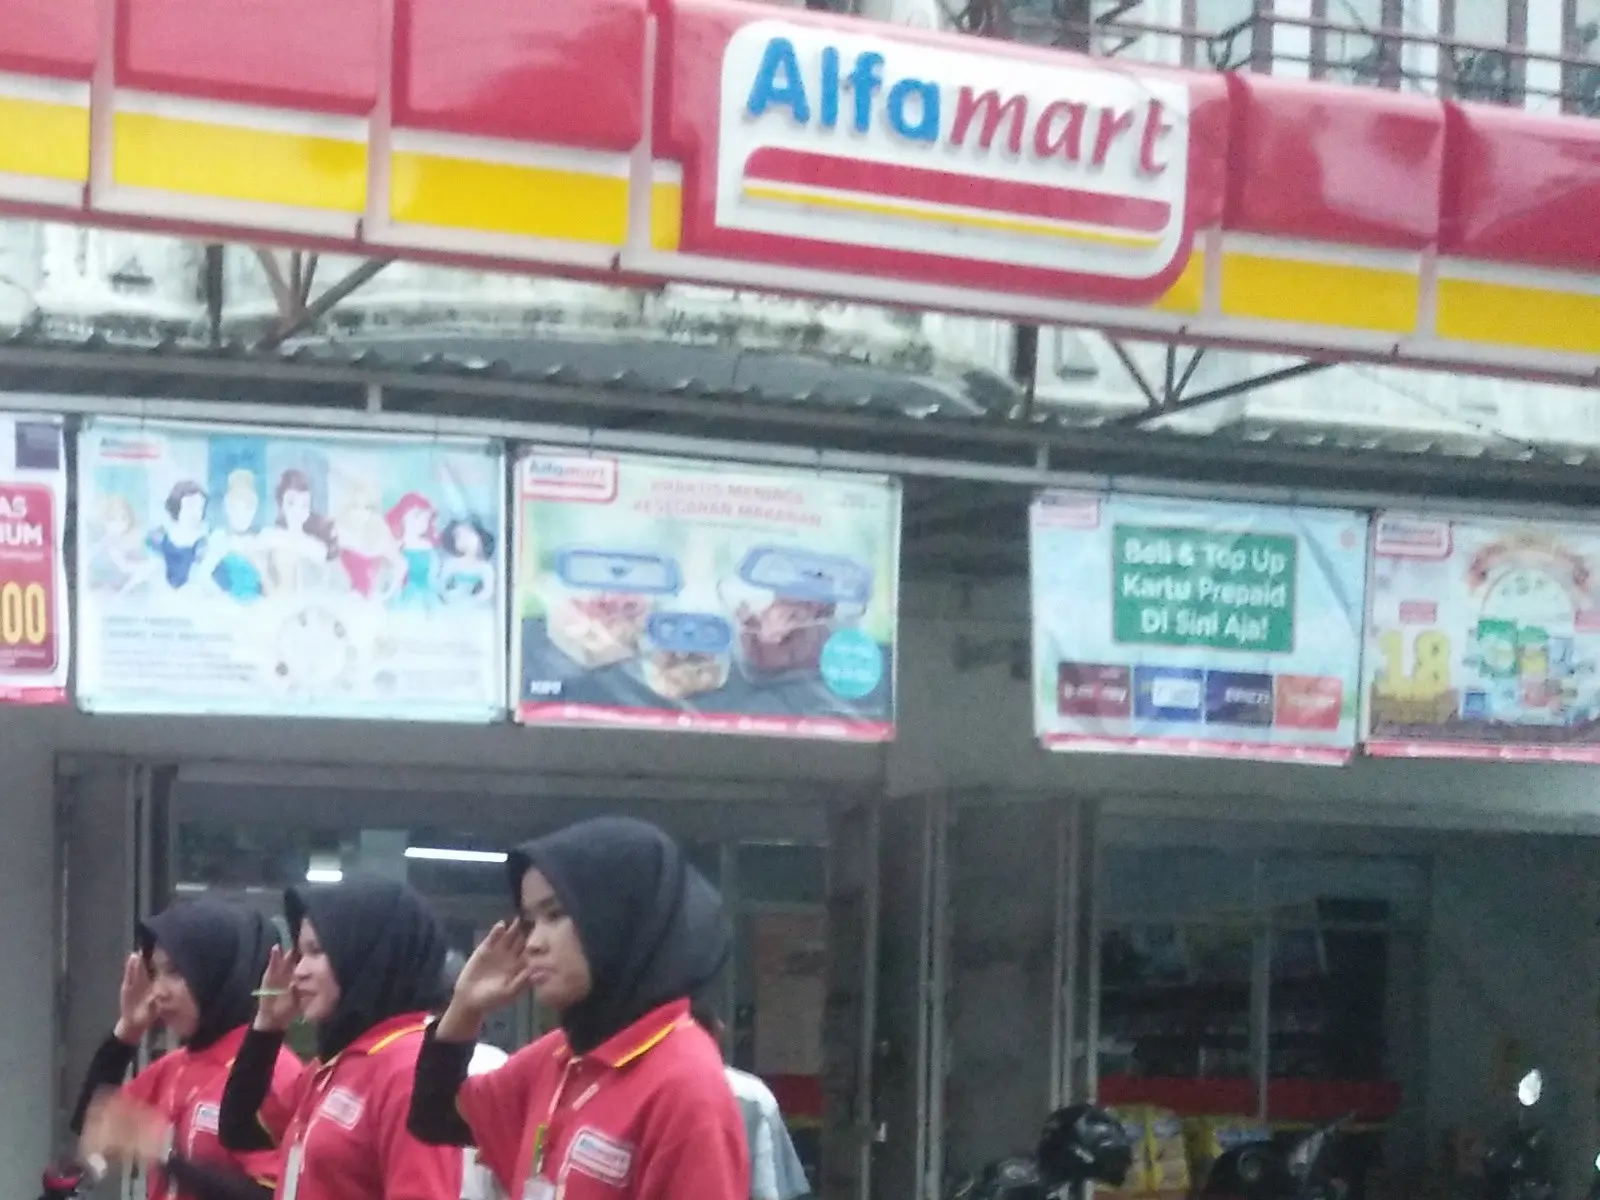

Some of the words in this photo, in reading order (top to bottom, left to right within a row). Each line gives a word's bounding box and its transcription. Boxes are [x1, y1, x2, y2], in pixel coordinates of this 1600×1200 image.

[746, 36, 1171, 175] Alfamart
[1124, 538, 1172, 564] Beli
[1201, 543, 1246, 575] Top
[1252, 548, 1287, 577] Up
[1123, 572, 1191, 600] Kartu
[1198, 576, 1287, 608] Prepaid
[1176, 608, 1219, 636] Sini
